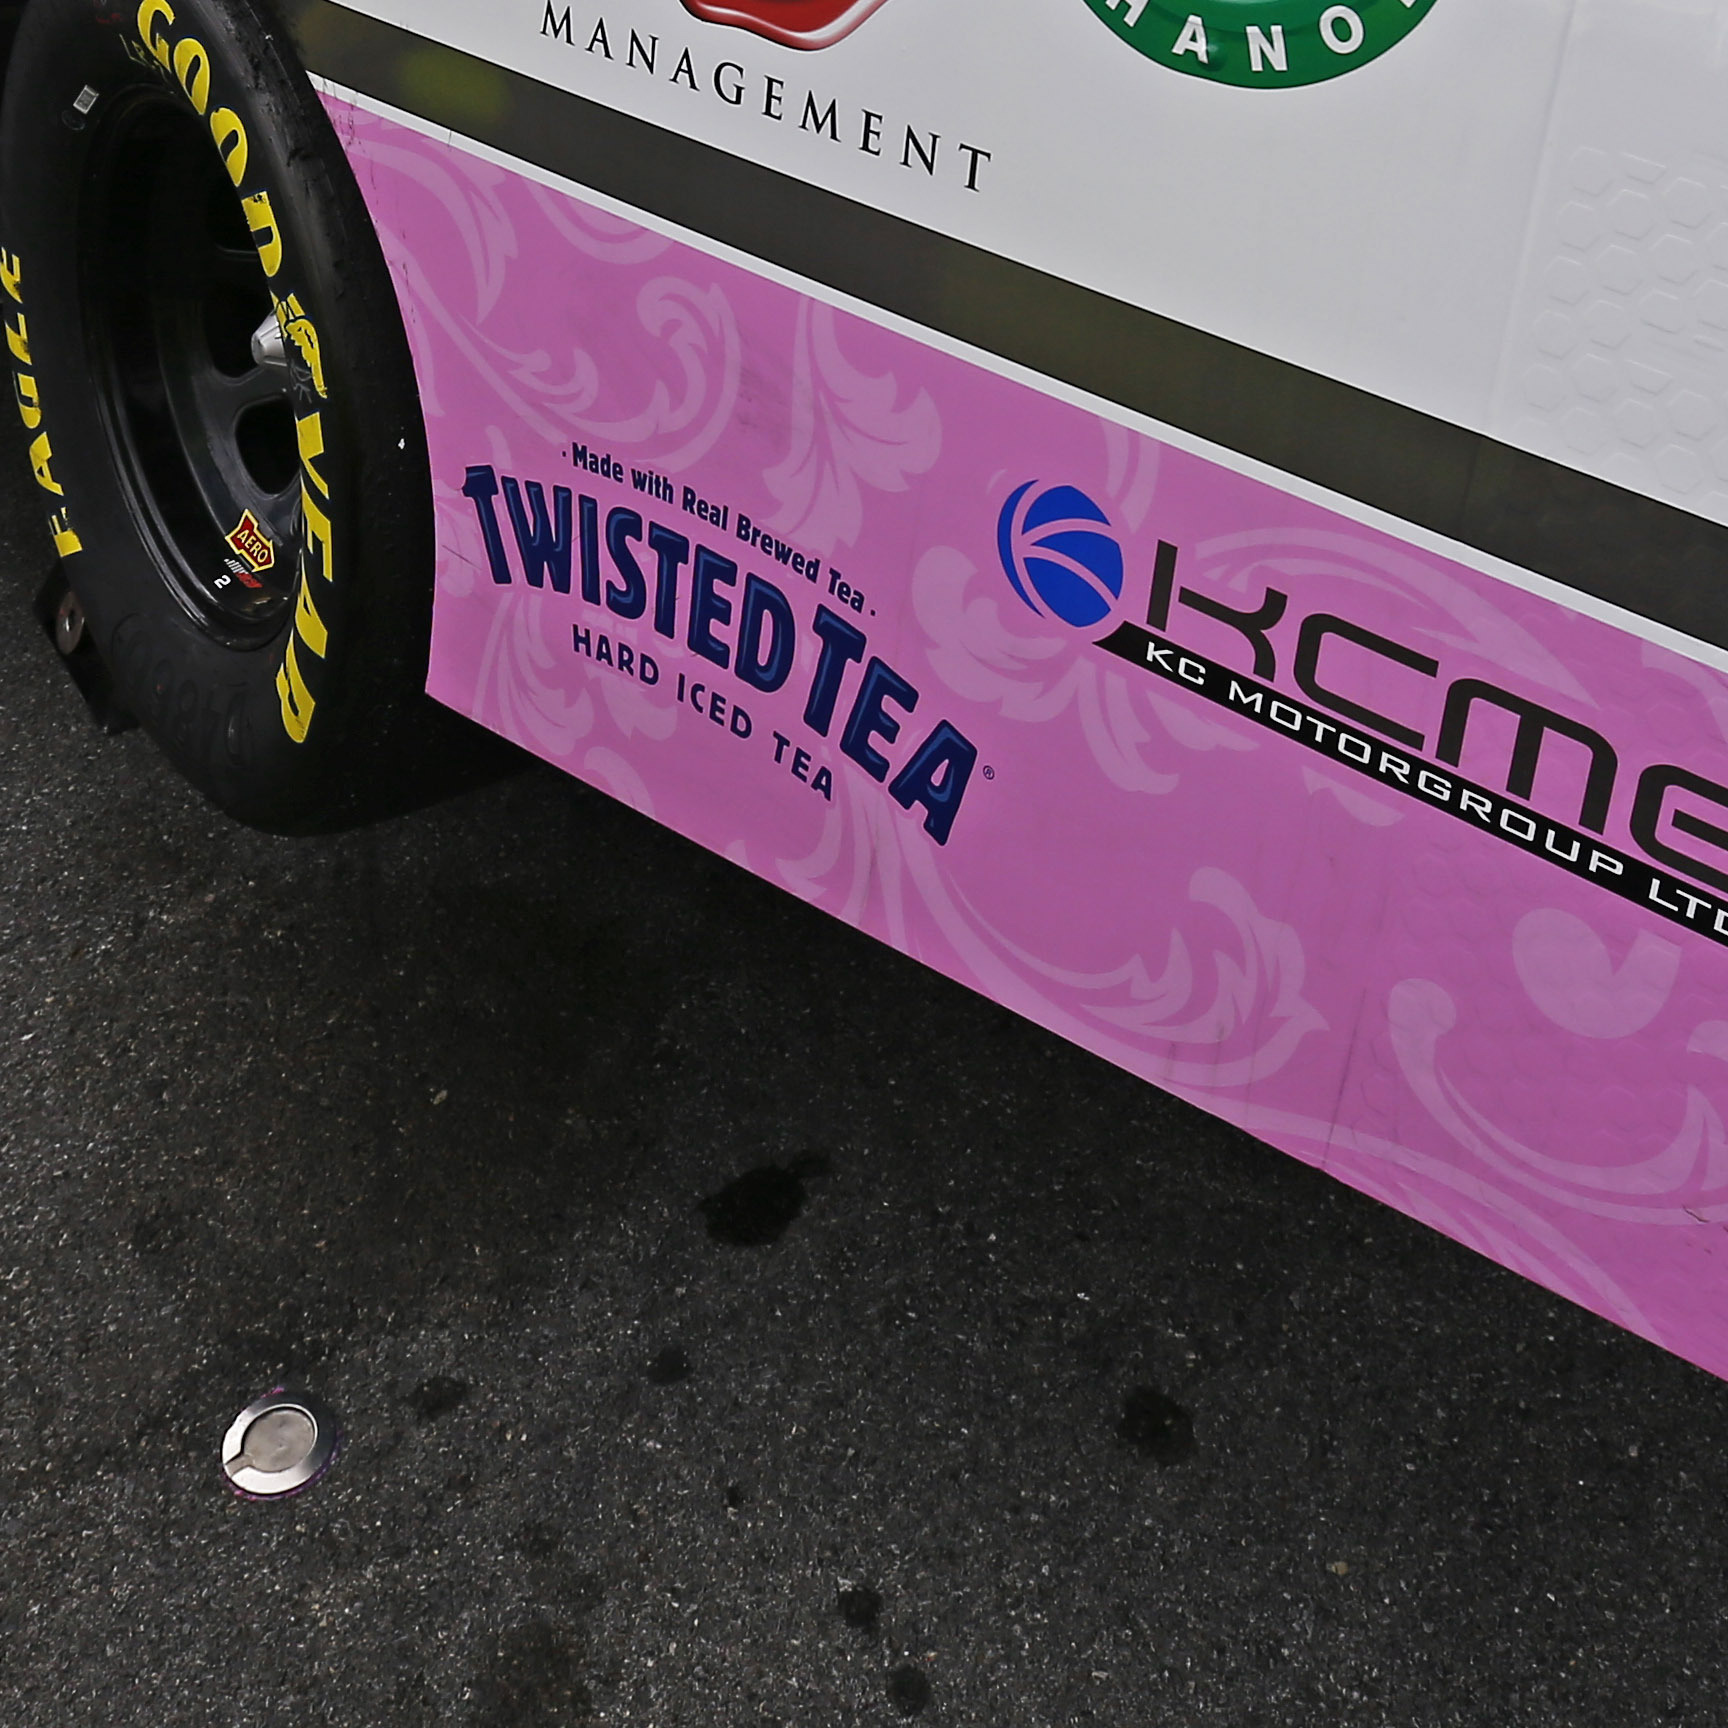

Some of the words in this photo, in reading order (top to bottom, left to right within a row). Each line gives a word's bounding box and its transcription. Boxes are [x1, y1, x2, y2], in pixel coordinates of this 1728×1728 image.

[213, 573, 232, 590] 2
[235, 528, 269, 564] AERO
[573, 442, 624, 483] Made
[631, 467, 674, 505] with
[682, 486, 729, 532] Real
[736, 512, 821, 585] Brewed
[828, 567, 866, 612] Tea
[463, 465, 796, 694] TWISTED
[803, 604, 978, 847] TEA
[573, 624, 660, 686] HARD
[677, 672, 753, 740] ICED
[772, 731, 833, 802] TEA
[1144, 641, 1208, 687] KC
[1228, 679, 1626, 877] MOTORGROUP
